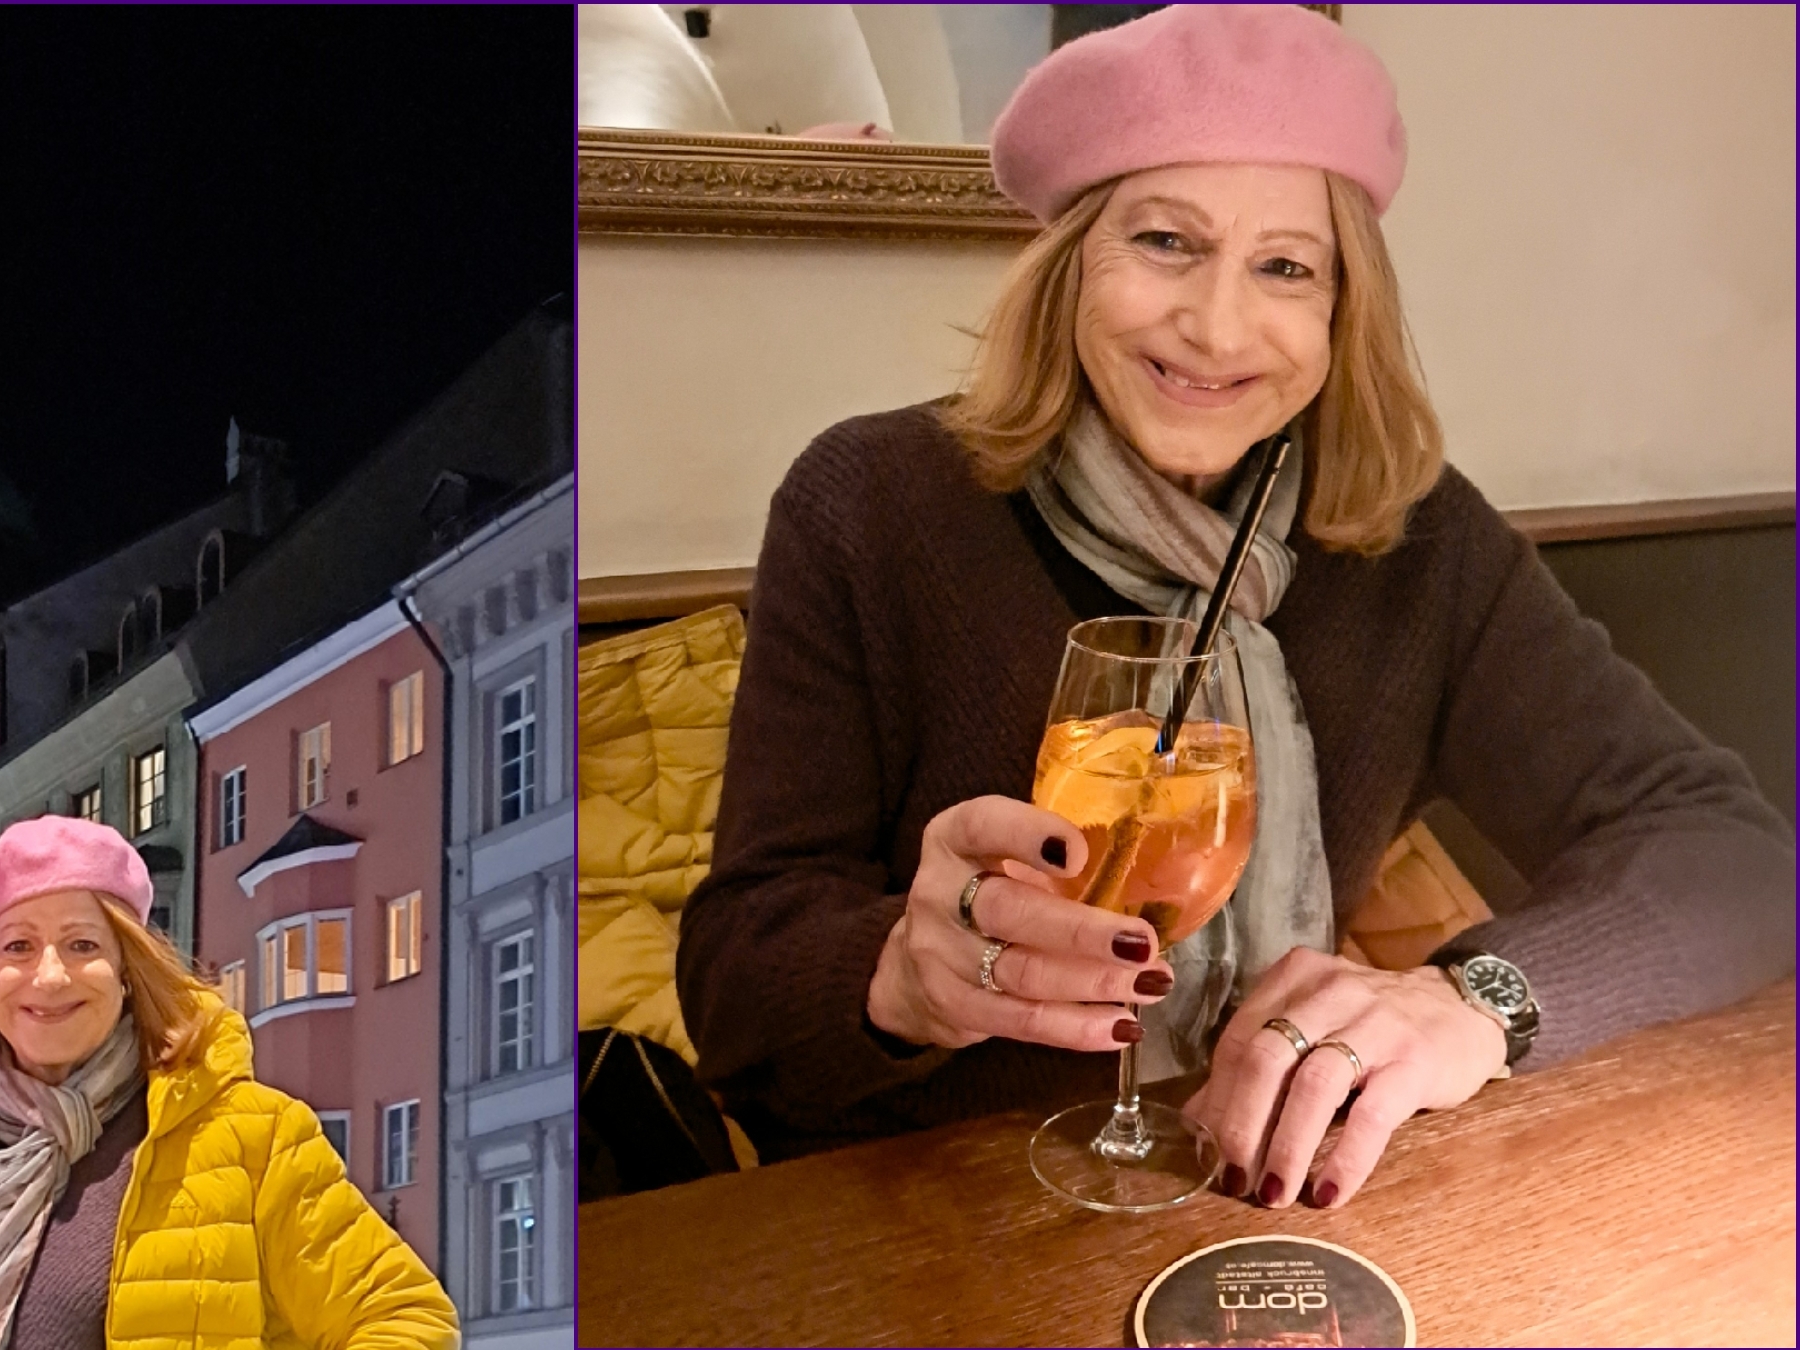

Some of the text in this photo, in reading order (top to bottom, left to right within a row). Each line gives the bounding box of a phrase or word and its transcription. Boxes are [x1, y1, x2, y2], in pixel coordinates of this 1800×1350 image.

[1216, 1269, 1325, 1279] innsbruck altstadt
[1217, 1284, 1250, 1292] bar
[1218, 1291, 1328, 1316] dom
